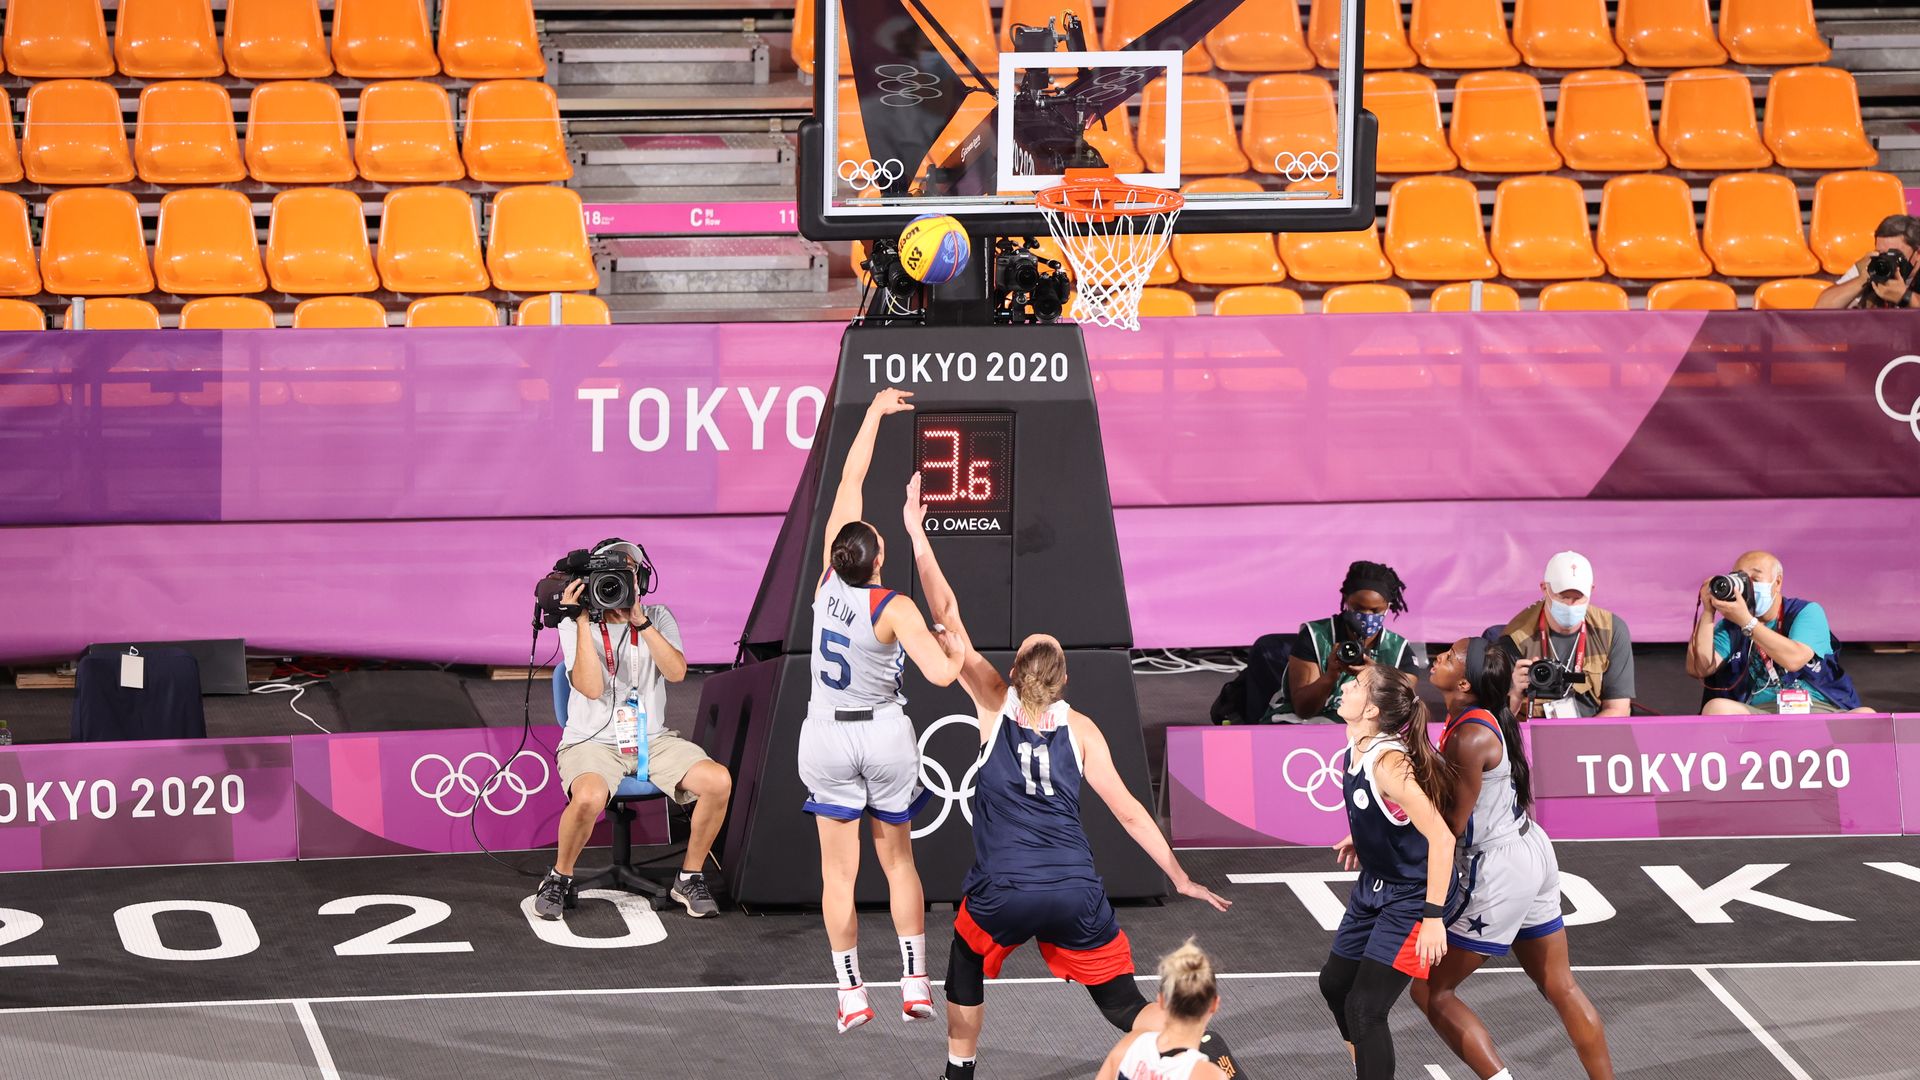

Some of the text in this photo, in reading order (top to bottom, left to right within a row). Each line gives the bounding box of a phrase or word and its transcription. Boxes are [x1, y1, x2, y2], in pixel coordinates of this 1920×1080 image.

[584, 211, 601, 225] 18
[690, 208, 703, 227] C
[863, 352, 1068, 384] TOKYO 2020
[578, 385, 827, 453] TOKYO
[922, 430, 991, 500] 3.6
[943, 517, 1001, 531] OMEGA
[827, 596, 857, 628] PLUM
[819, 627, 852, 691] 5
[1017, 741, 1055, 796] 11
[1577, 748, 1850, 795] TOKYO 2020
[130, 774, 245, 818] 2020
